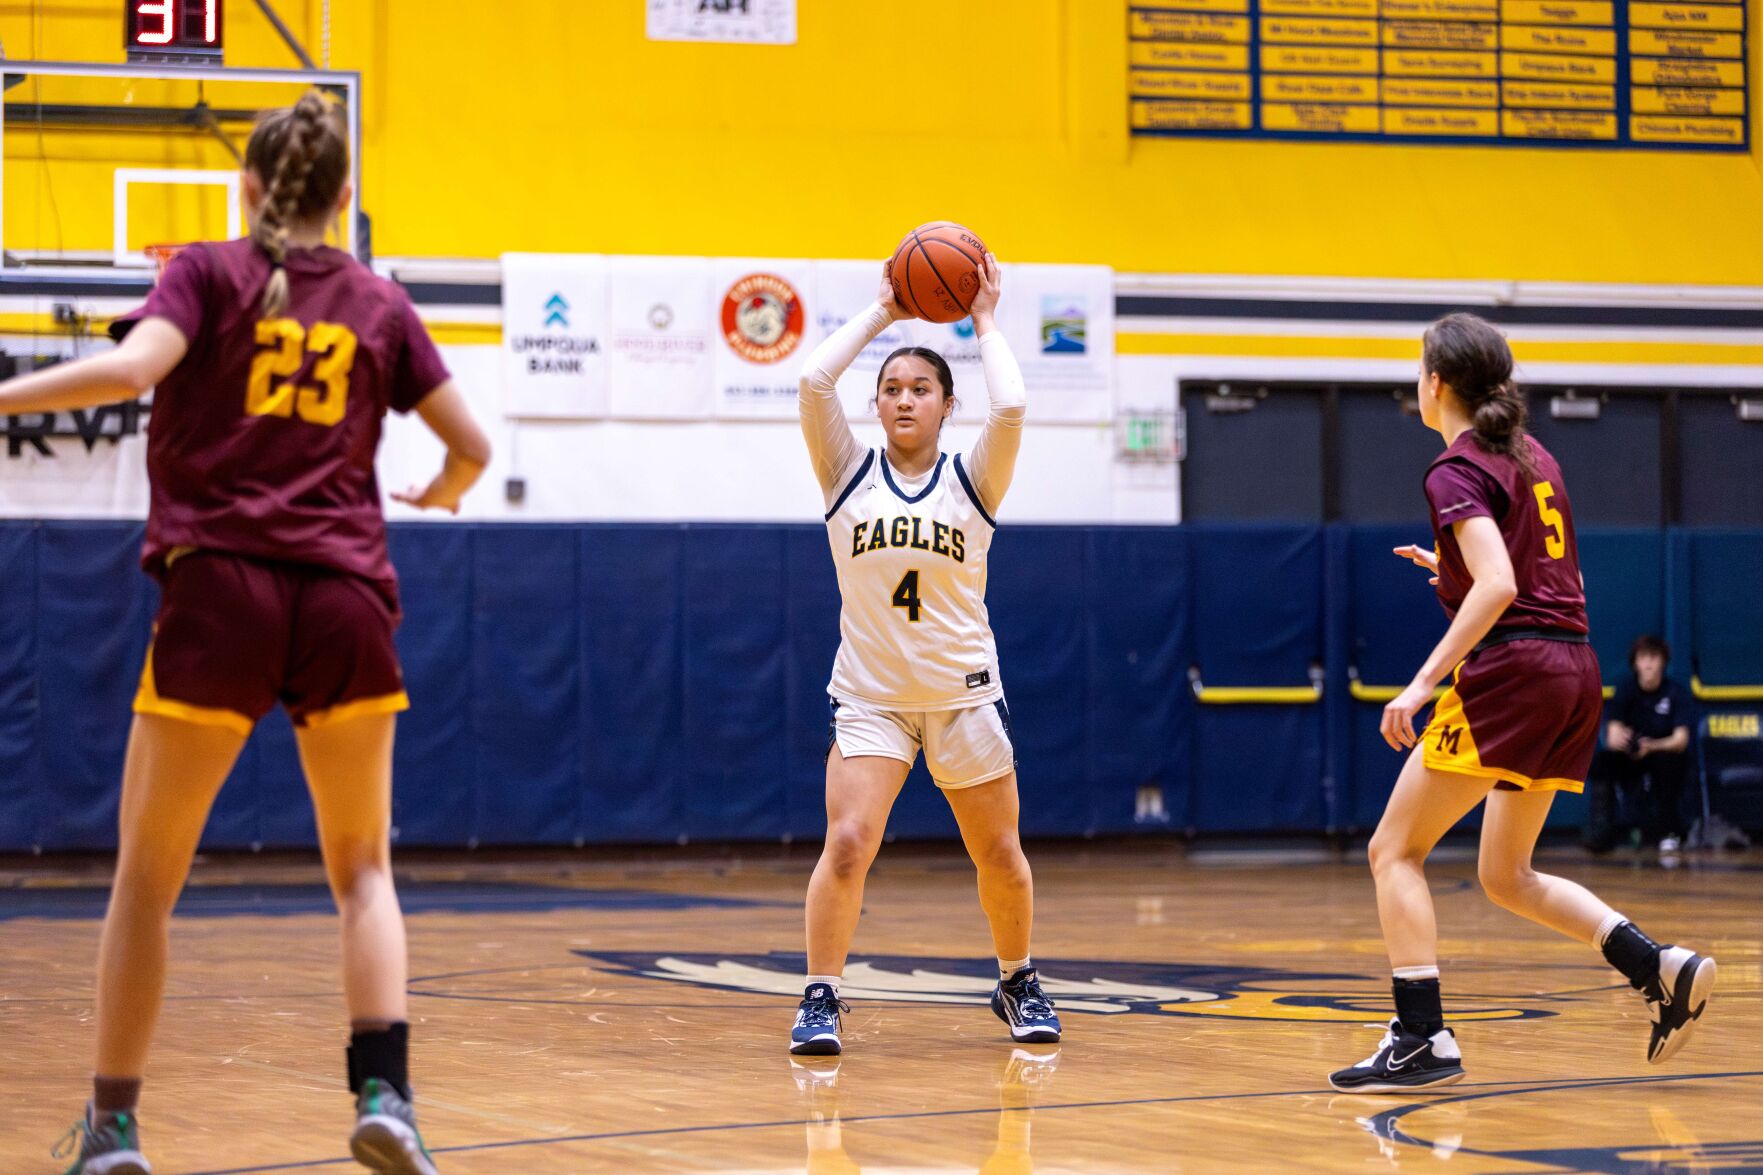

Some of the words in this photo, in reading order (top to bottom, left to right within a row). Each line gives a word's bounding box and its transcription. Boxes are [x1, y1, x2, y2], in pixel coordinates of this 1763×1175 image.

[511, 334, 601, 355] UMPQUA
[526, 357, 585, 375] BANK
[245, 318, 357, 427] 23
[851, 515, 967, 564] EAGLES
[1533, 481, 1566, 560] 5
[891, 568, 924, 624] 4
[1436, 725, 1464, 756] M
